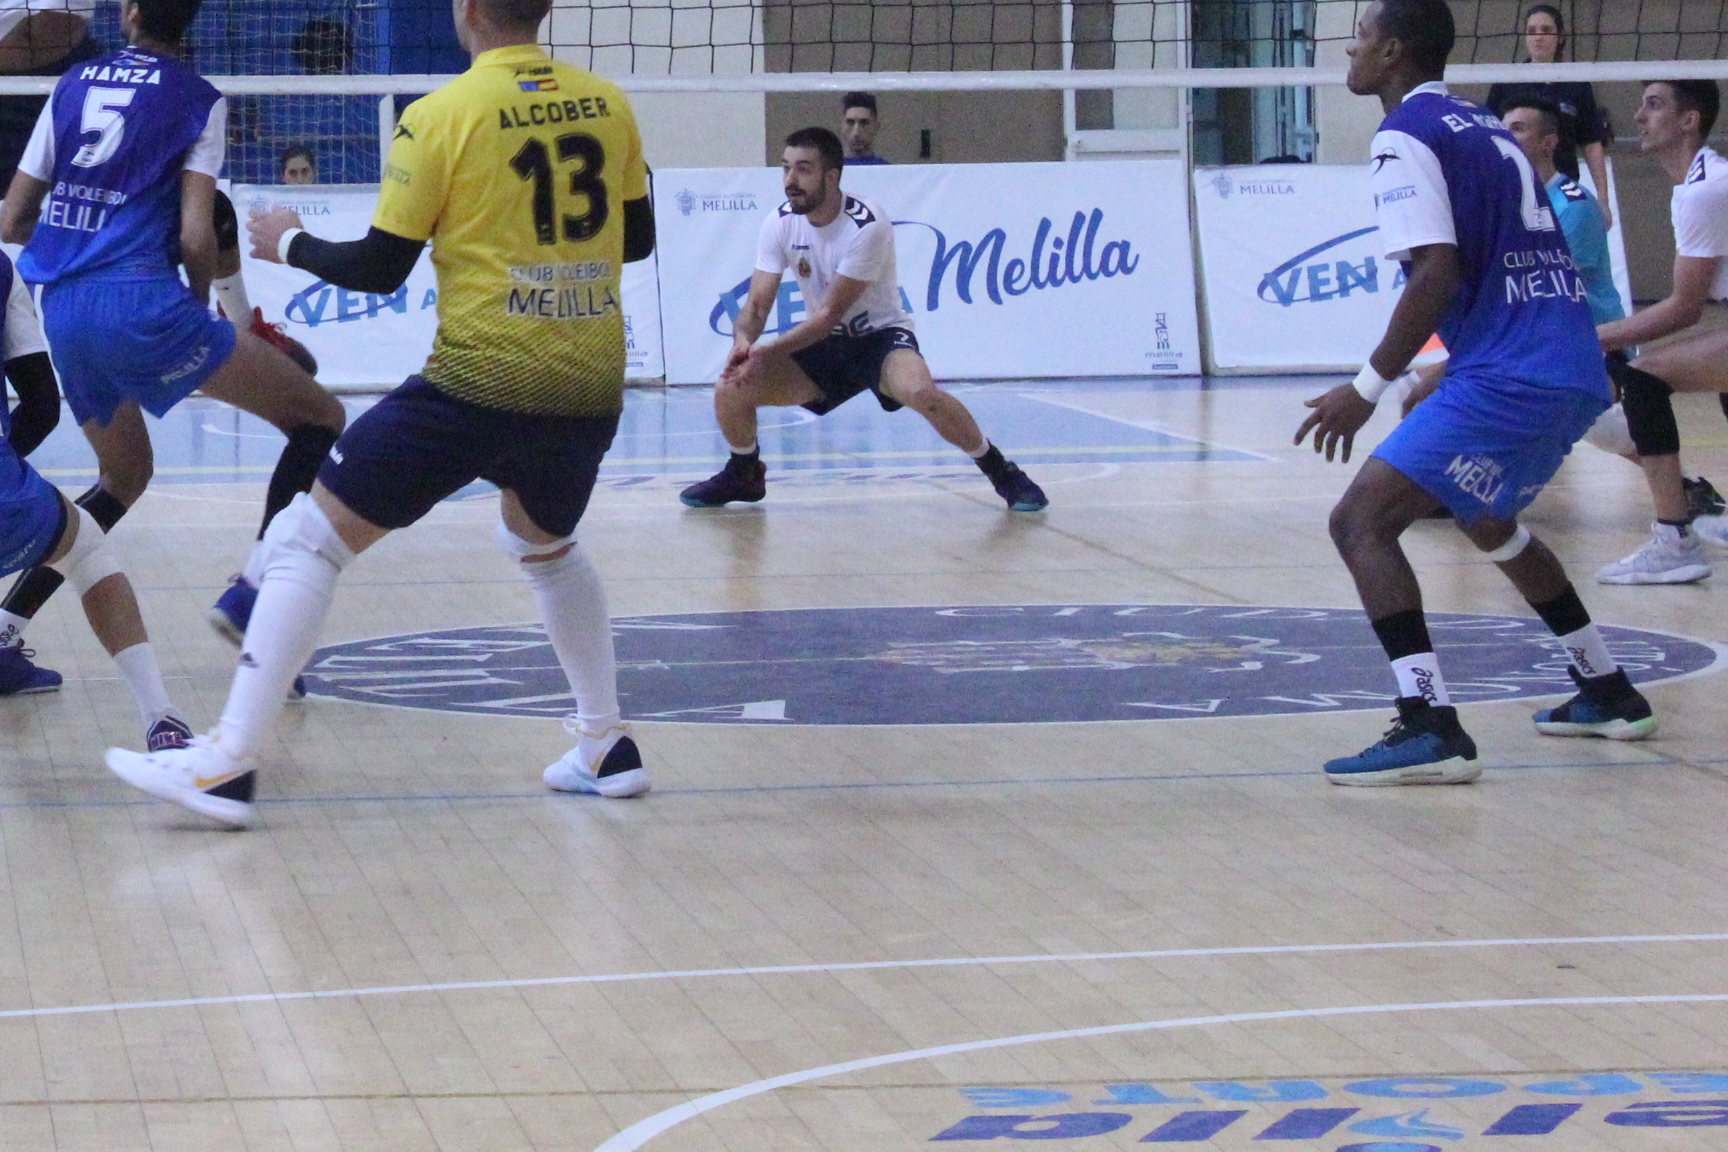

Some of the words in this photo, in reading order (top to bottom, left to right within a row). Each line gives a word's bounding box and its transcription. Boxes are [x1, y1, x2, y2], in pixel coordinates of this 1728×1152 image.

[80, 65, 161, 85] HAMZA
[71, 85, 137, 168] 5
[498, 97, 611, 130] ALCOBER
[1441, 113, 1474, 133] EL
[509, 131, 609, 245] 13
[1240, 184, 1295, 195] MELILLA
[1383, 189, 1417, 204] MELILLA
[1490, 135, 1556, 232] 2
[282, 205, 330, 216] ELILLA
[702, 200, 758, 211] MELILLA
[926, 208, 1139, 311] Melilla
[1264, 256, 1379, 307] VEN
[293, 280, 407, 327] VEN
[509, 287, 619, 318] MELILLA
[1412, 668, 1438, 702] asics
